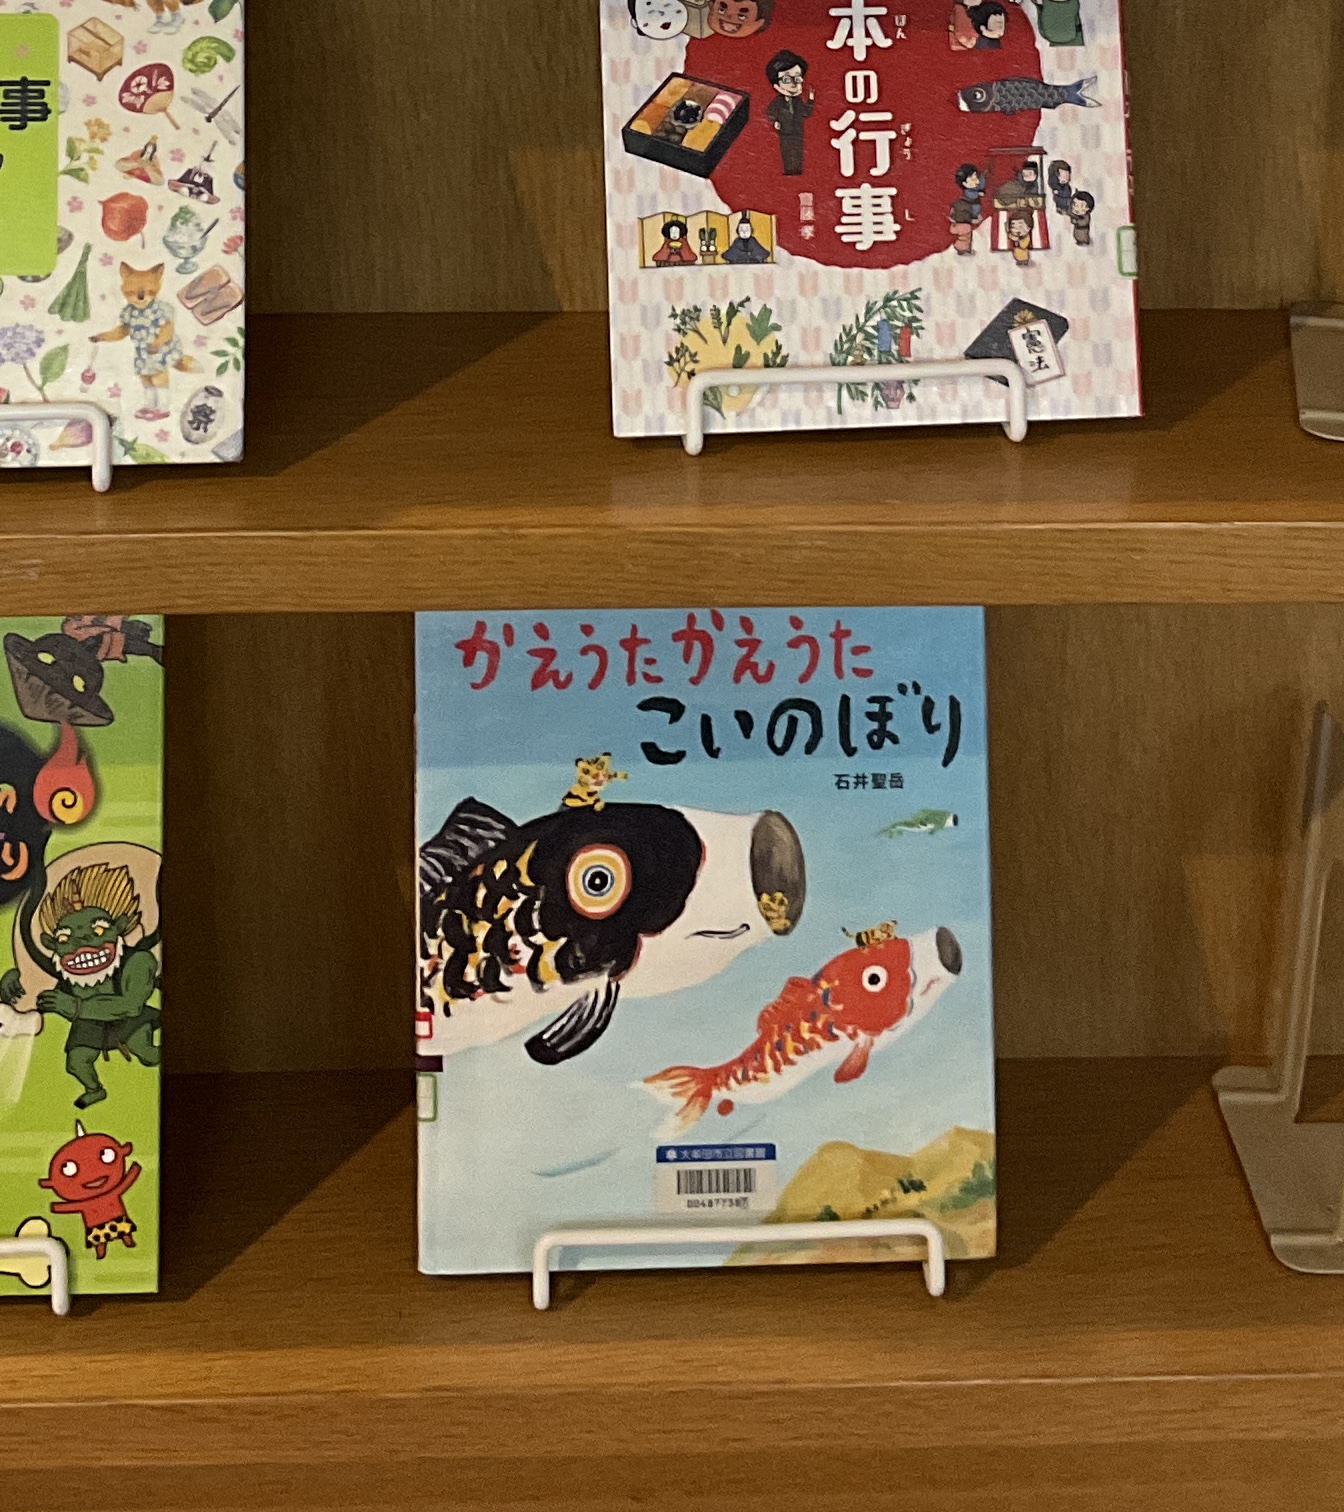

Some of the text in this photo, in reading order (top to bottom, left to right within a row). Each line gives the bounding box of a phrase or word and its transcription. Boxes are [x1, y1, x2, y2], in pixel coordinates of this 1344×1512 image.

[455, 609, 875, 691] かえうたかえうた
[636, 681, 963, 768] こいのぼり
[833, 772, 905, 791] 石井聖岳
